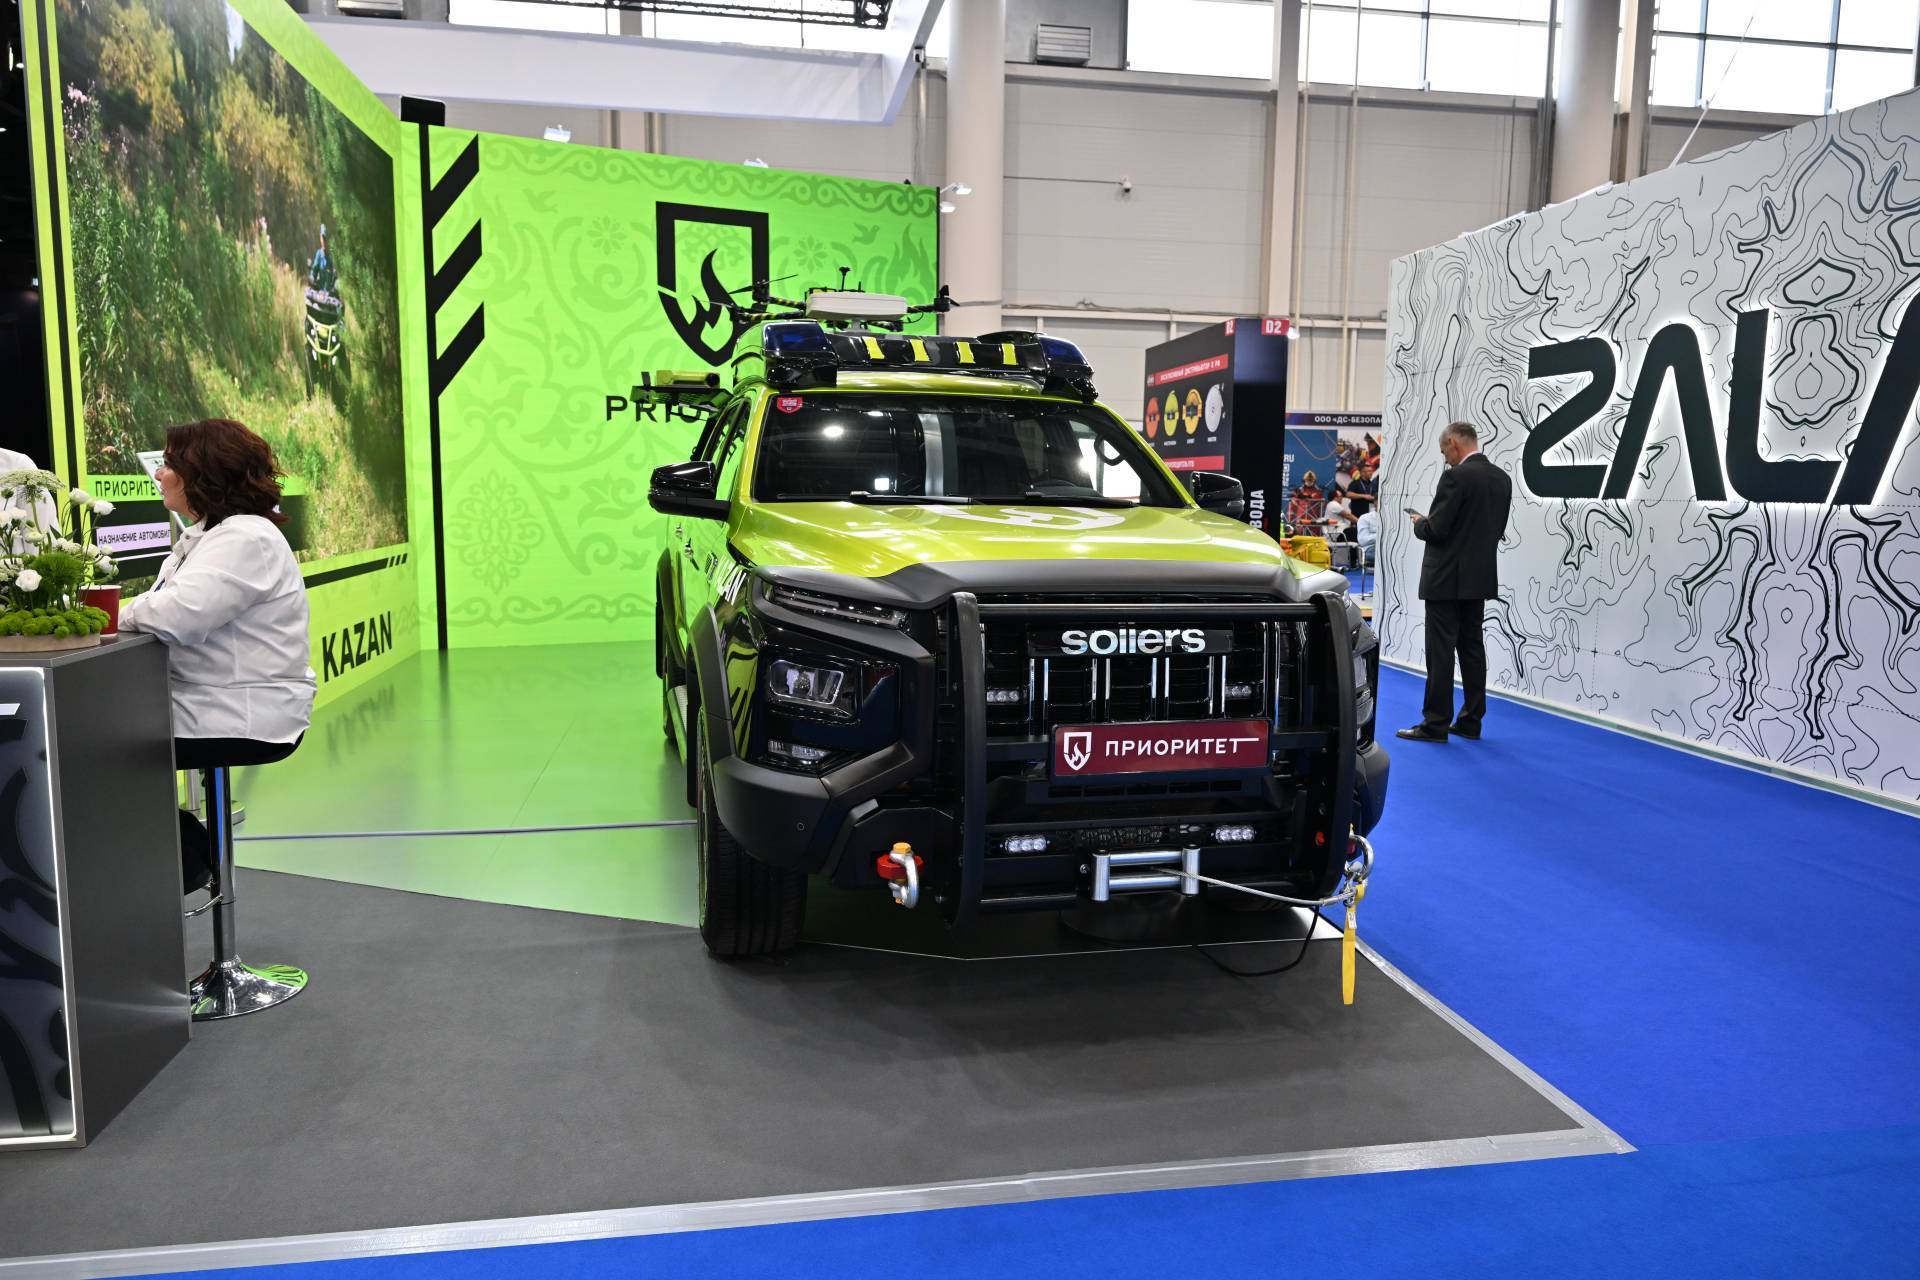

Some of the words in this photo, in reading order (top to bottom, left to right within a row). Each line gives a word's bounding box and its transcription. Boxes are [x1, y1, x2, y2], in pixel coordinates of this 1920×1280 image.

[1265, 320, 1281, 333] D2
[1314, 415, 1331, 423] ООО
[1333, 416, 1382, 424] «ДС-БЕЗОПА
[95, 480, 159, 497] ПРИОРИТЕ
[98, 532, 137, 545] НАЗНАЧЕНИЕ
[321, 610, 393, 683] KAZAN
[1061, 623, 1206, 655] sollers
[1105, 737, 1260, 757] ПРИОРИТЕТ
